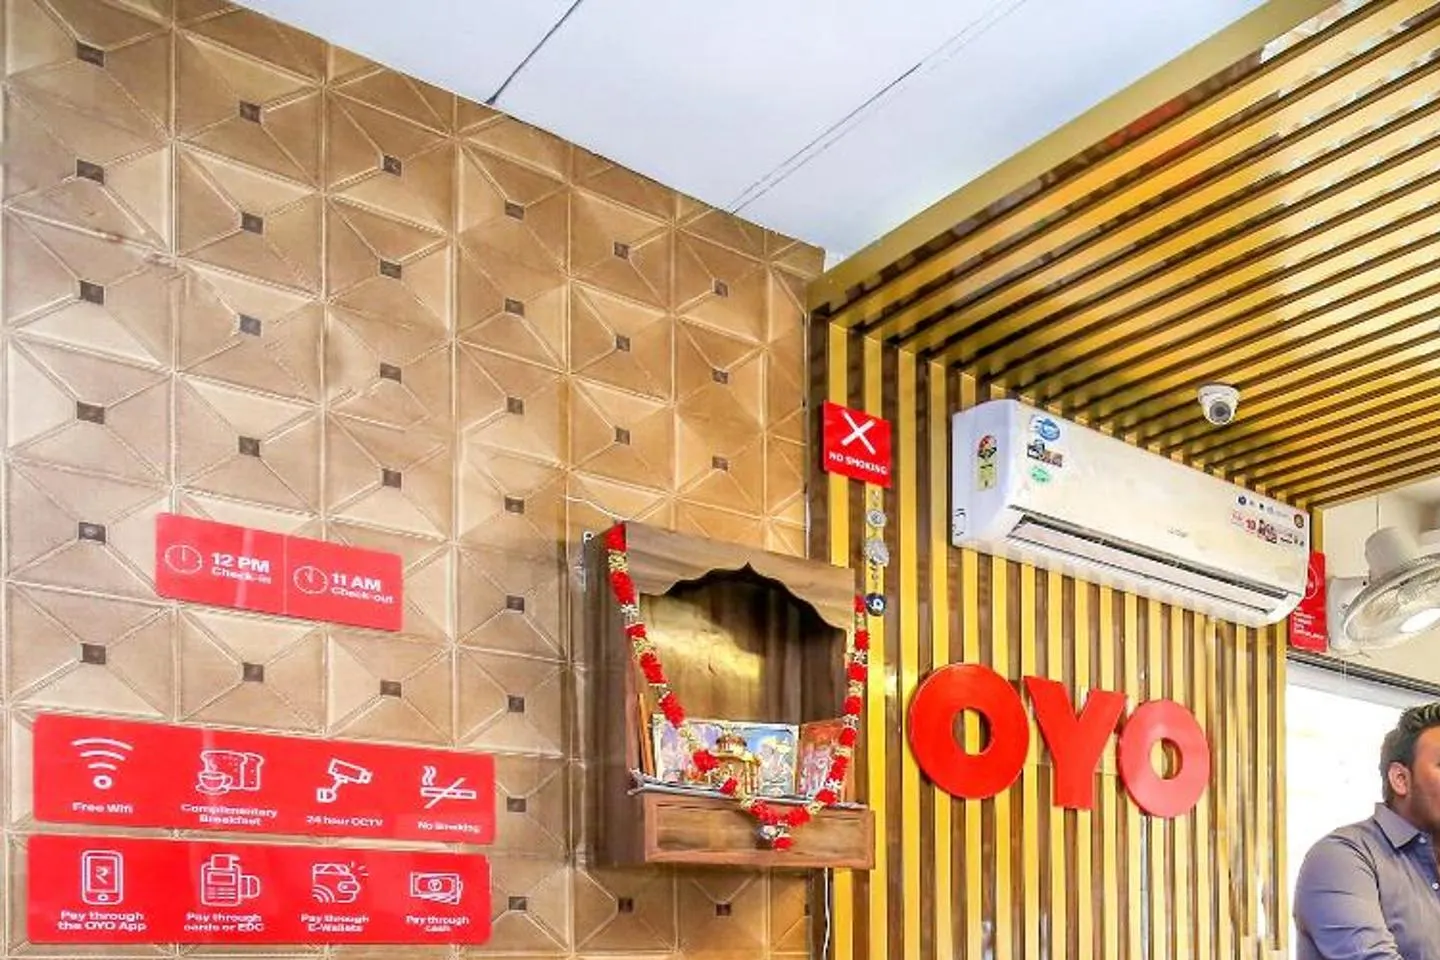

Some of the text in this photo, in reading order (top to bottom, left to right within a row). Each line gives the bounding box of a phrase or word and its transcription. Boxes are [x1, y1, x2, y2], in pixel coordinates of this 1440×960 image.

[829, 451, 888, 475] NO SMOKING
[211, 552, 270, 573] 12 PM
[211, 566, 272, 584] Check-in
[331, 572, 382, 592] 11 AM
[331, 586, 394, 604] Check-out
[908, 662, 1210, 818] OYO
[72, 802, 104, 813] Free
[180, 804, 278, 819] Complimentary
[199, 815, 261, 826] Breakfast
[323, 815, 349, 825] hour
[350, 816, 384, 828] CCTV
[417, 821, 433, 831] No
[60, 910, 145, 921] Pay through
[186, 911, 262, 923] Pay through
[301, 913, 369, 924] Pay through
[406, 915, 470, 926] Pay through
[57, 921, 147, 932] the OYO App
[237, 922, 265, 932] EDC
